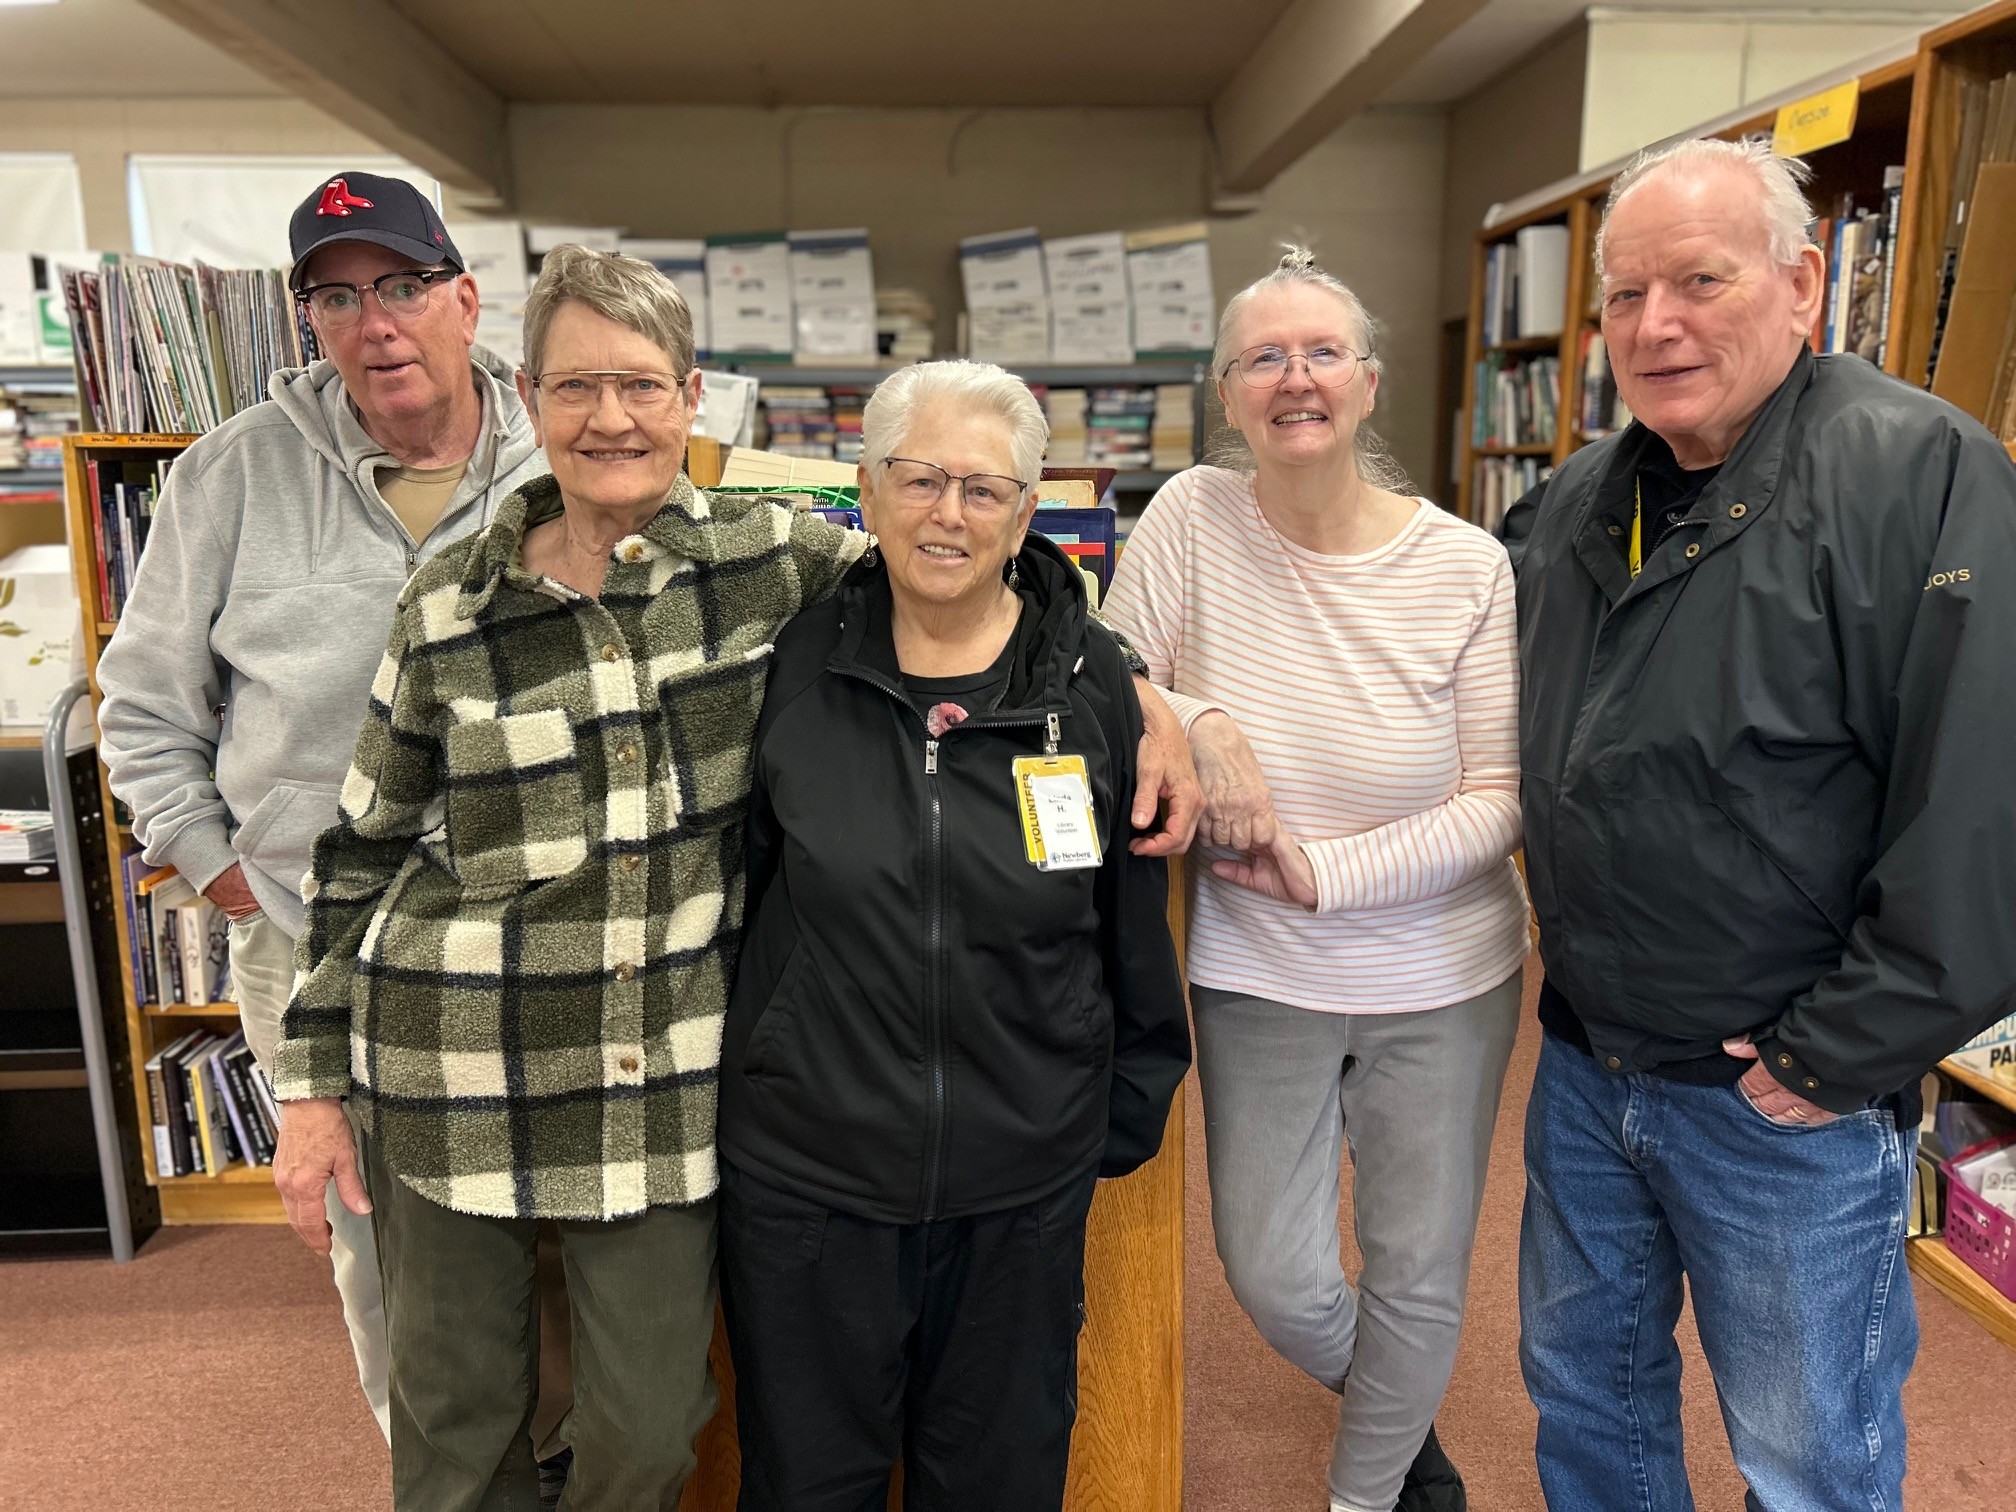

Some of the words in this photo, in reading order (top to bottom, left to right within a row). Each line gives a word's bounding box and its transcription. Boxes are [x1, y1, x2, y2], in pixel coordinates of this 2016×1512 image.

[1923, 568, 1971, 591] JOYS
[1061, 850, 1092, 859] Newberg
[1990, 1043, 2016, 1068] PA
